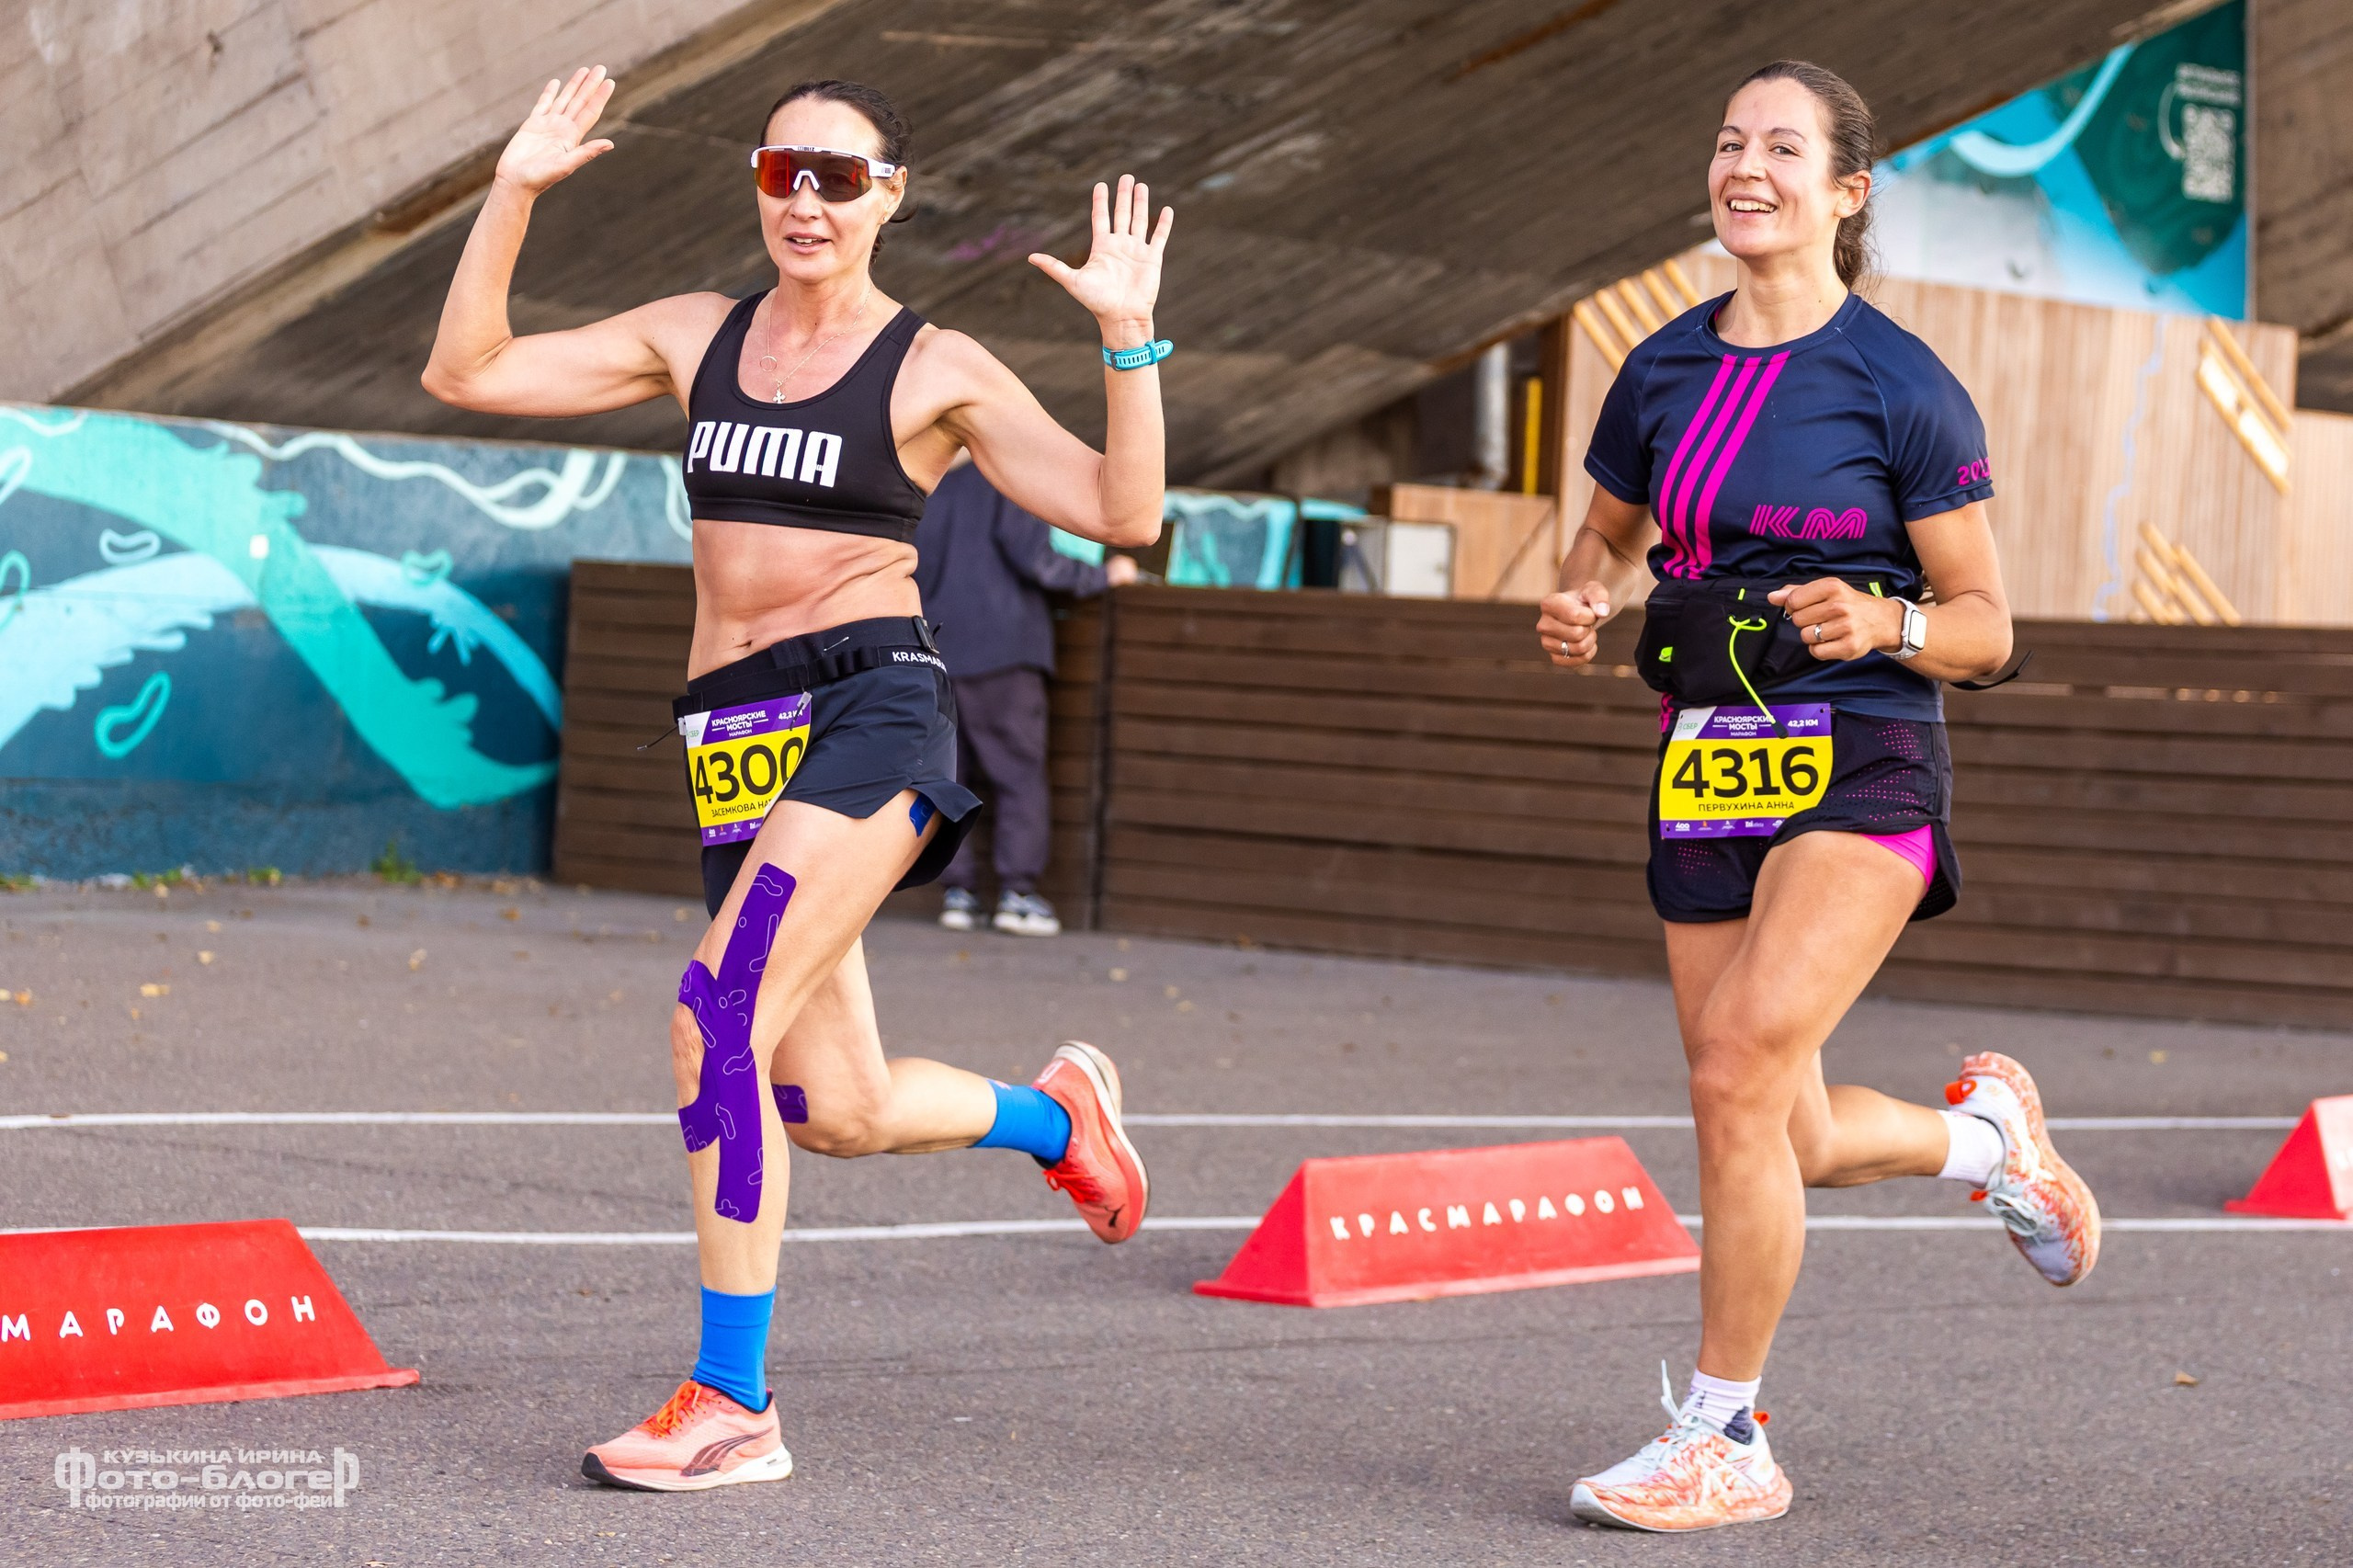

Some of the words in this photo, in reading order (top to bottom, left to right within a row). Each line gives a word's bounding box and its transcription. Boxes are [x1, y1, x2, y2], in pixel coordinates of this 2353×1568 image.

[688, 421, 843, 488] PUMA
[711, 710, 767, 727] КРАСНОЯРСКИЕ
[726, 721, 753, 732] МОСТЫ
[1714, 715, 1775, 724] КРАСНОЯРСКИ
[1729, 722, 1757, 731] МОСТЫ
[695, 736, 804, 804] 4300
[1672, 746, 1819, 798] 4316
[1699, 802, 1763, 812] ПЕРВУХИНА
[1328, 1186, 1644, 1241] КРАСМАРАФОН
[0, 1294, 316, 1343] МАРАФОН
